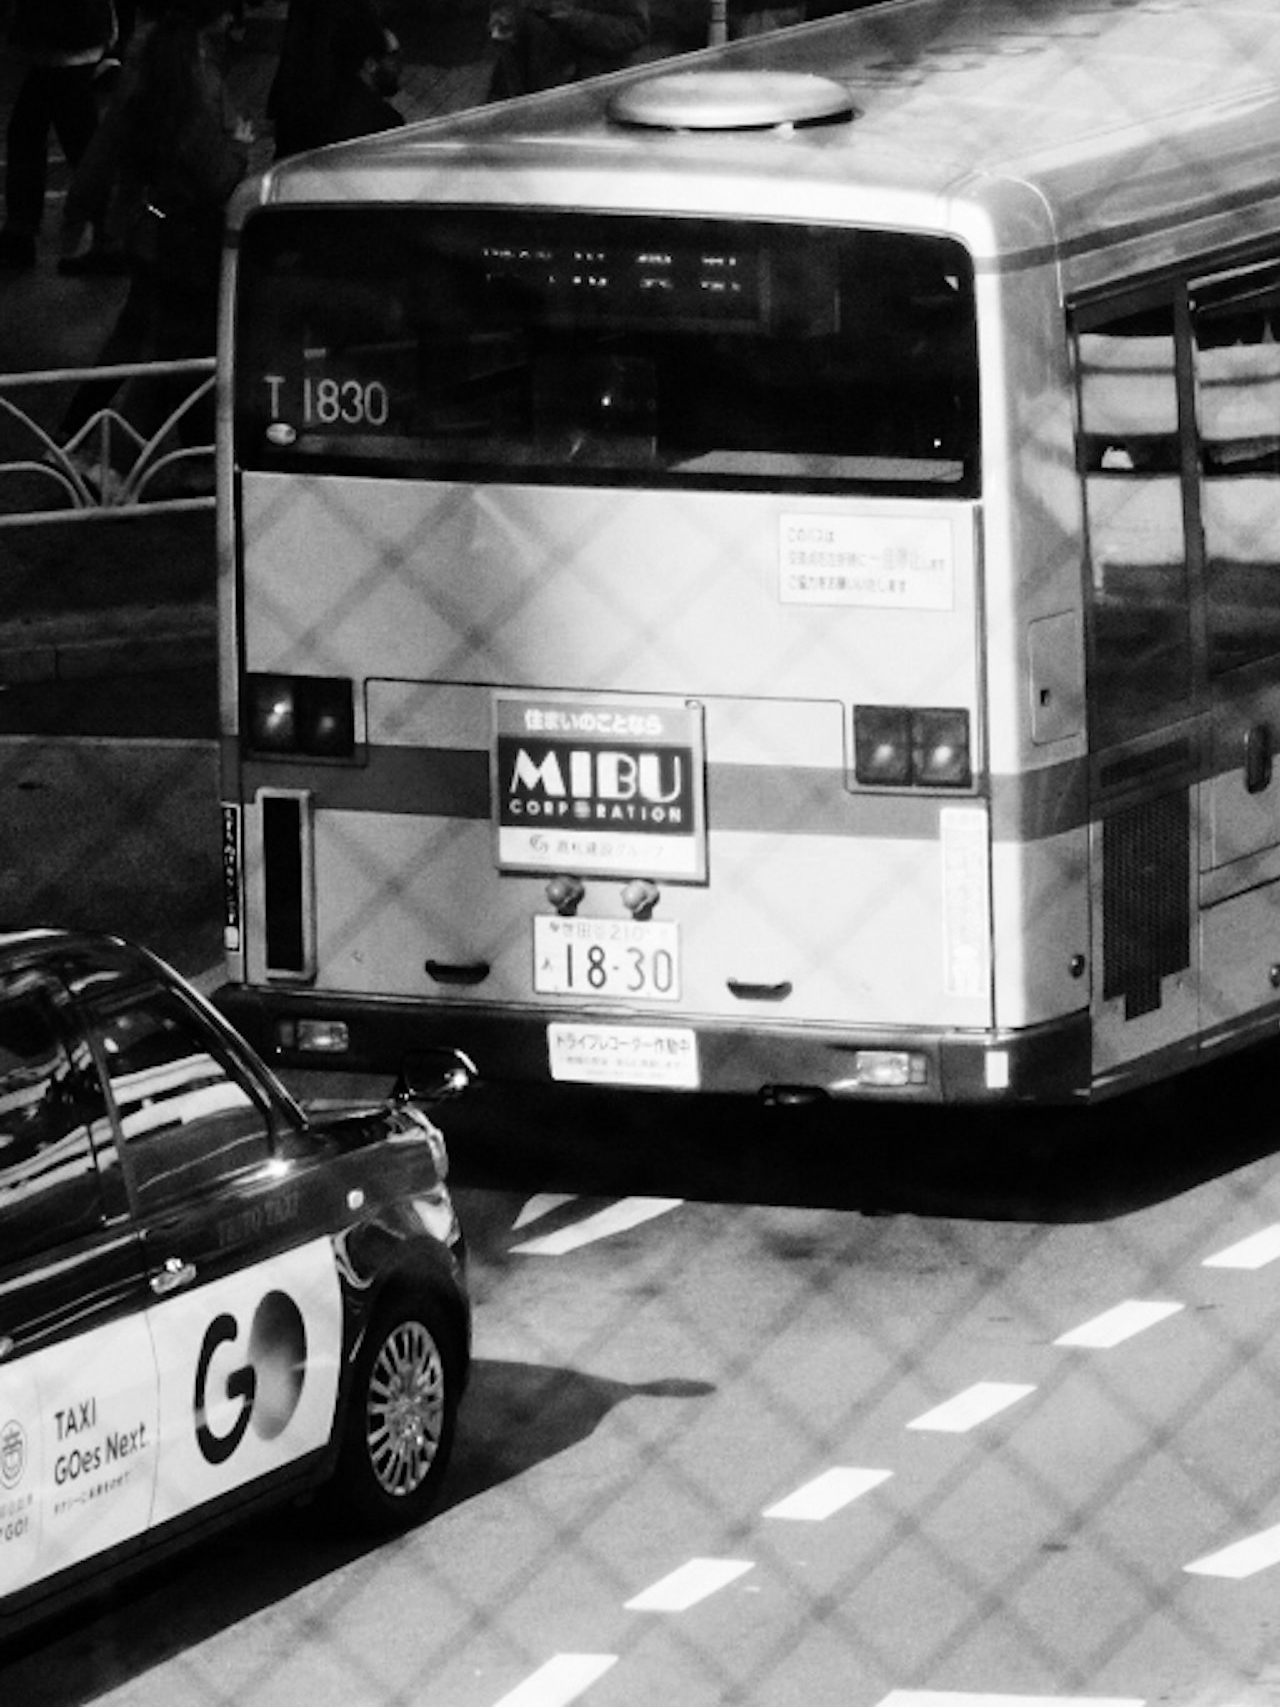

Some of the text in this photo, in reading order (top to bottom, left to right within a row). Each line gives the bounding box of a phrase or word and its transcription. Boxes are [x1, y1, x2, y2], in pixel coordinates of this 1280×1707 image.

[265, 375, 389, 426] T 1830
[524, 708, 664, 736] 住まいのことなら
[508, 747, 683, 803] MIBU
[508, 798, 683, 825] CORPORATION
[566, 943, 673, 993] 18-30
[193, 1288, 308, 1465] GO
[53, 1396, 97, 1441] TAXI
[54, 1446, 102, 1485] GOes
